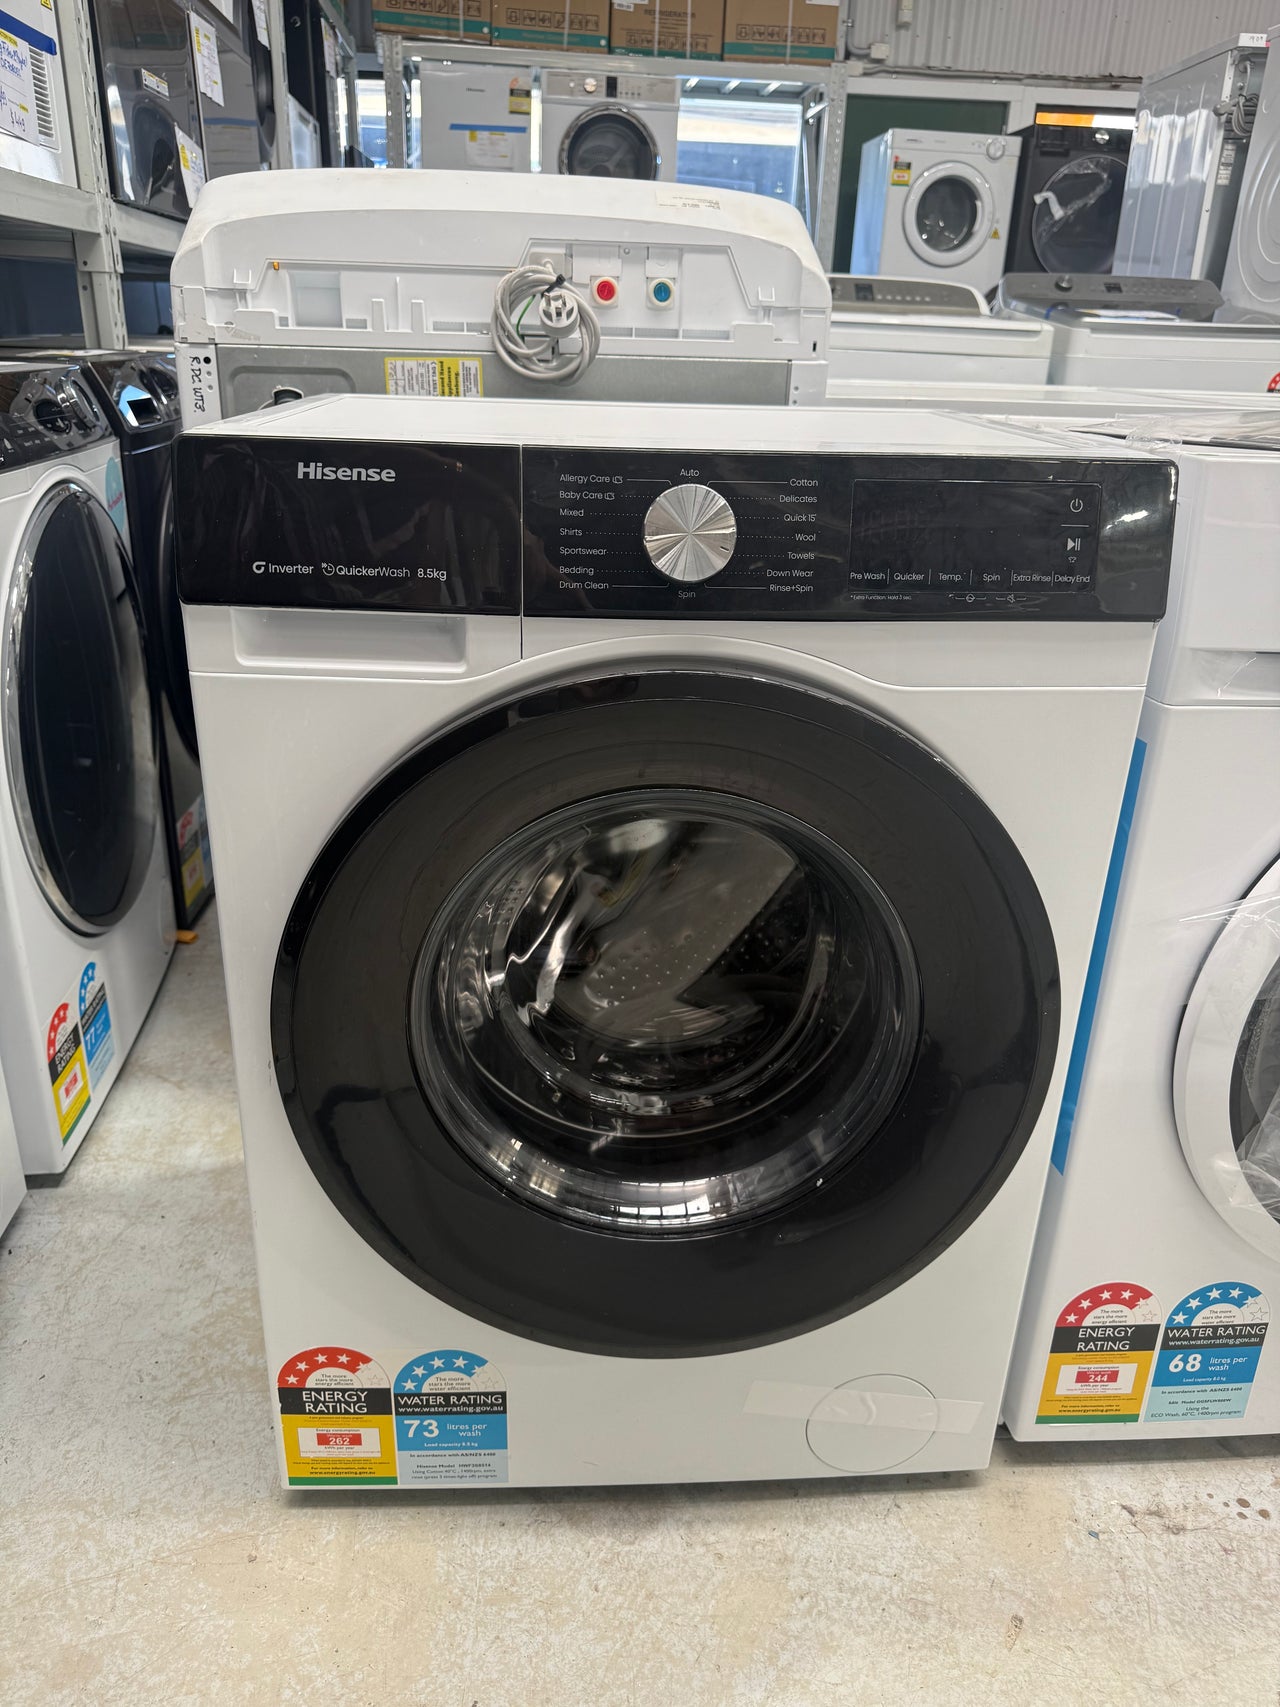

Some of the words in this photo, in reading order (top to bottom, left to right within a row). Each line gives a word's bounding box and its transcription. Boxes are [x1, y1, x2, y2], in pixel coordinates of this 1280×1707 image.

[298, 462, 396, 482] Hisense
[680, 468, 700, 477] Auto
[560, 474, 588, 483] Allergy
[790, 478, 818, 486] Cotton
[560, 492, 582, 500] Baby
[560, 509, 584, 517] Mixed
[784, 514, 806, 522] Quick
[560, 528, 582, 536] Shirts
[560, 547, 607, 556] Sportswear
[268, 563, 314, 574] Inverter
[336, 565, 410, 578] QuickerWash
[418, 568, 446, 580] 8.5kg
[560, 566, 594, 575] Bedding
[982, 573, 1000, 581] Spin
[1054, 575, 1076, 583] Delay
[769, 584, 814, 592] Rinse+Spin
[678, 590, 696, 599] Spin
[86, 1027, 95, 1050] 77
[54, 1034, 75, 1065] ENERGY
[1078, 1327, 1136, 1338] ENERGY
[1168, 1328, 1213, 1338] WATER
[1217, 1326, 1266, 1336] RATING
[1169, 1337, 1260, 1346] www.waterrating.gov.au
[1077, 1341, 1130, 1352] RATING
[1168, 1353, 1202, 1373] 68
[1233, 1356, 1248, 1364] per
[302, 1390, 368, 1402] ENERGY
[398, 1396, 446, 1405] WATER
[450, 1395, 502, 1404] RATING
[305, 1402, 368, 1413] RATING
[404, 1420, 439, 1438] 73
